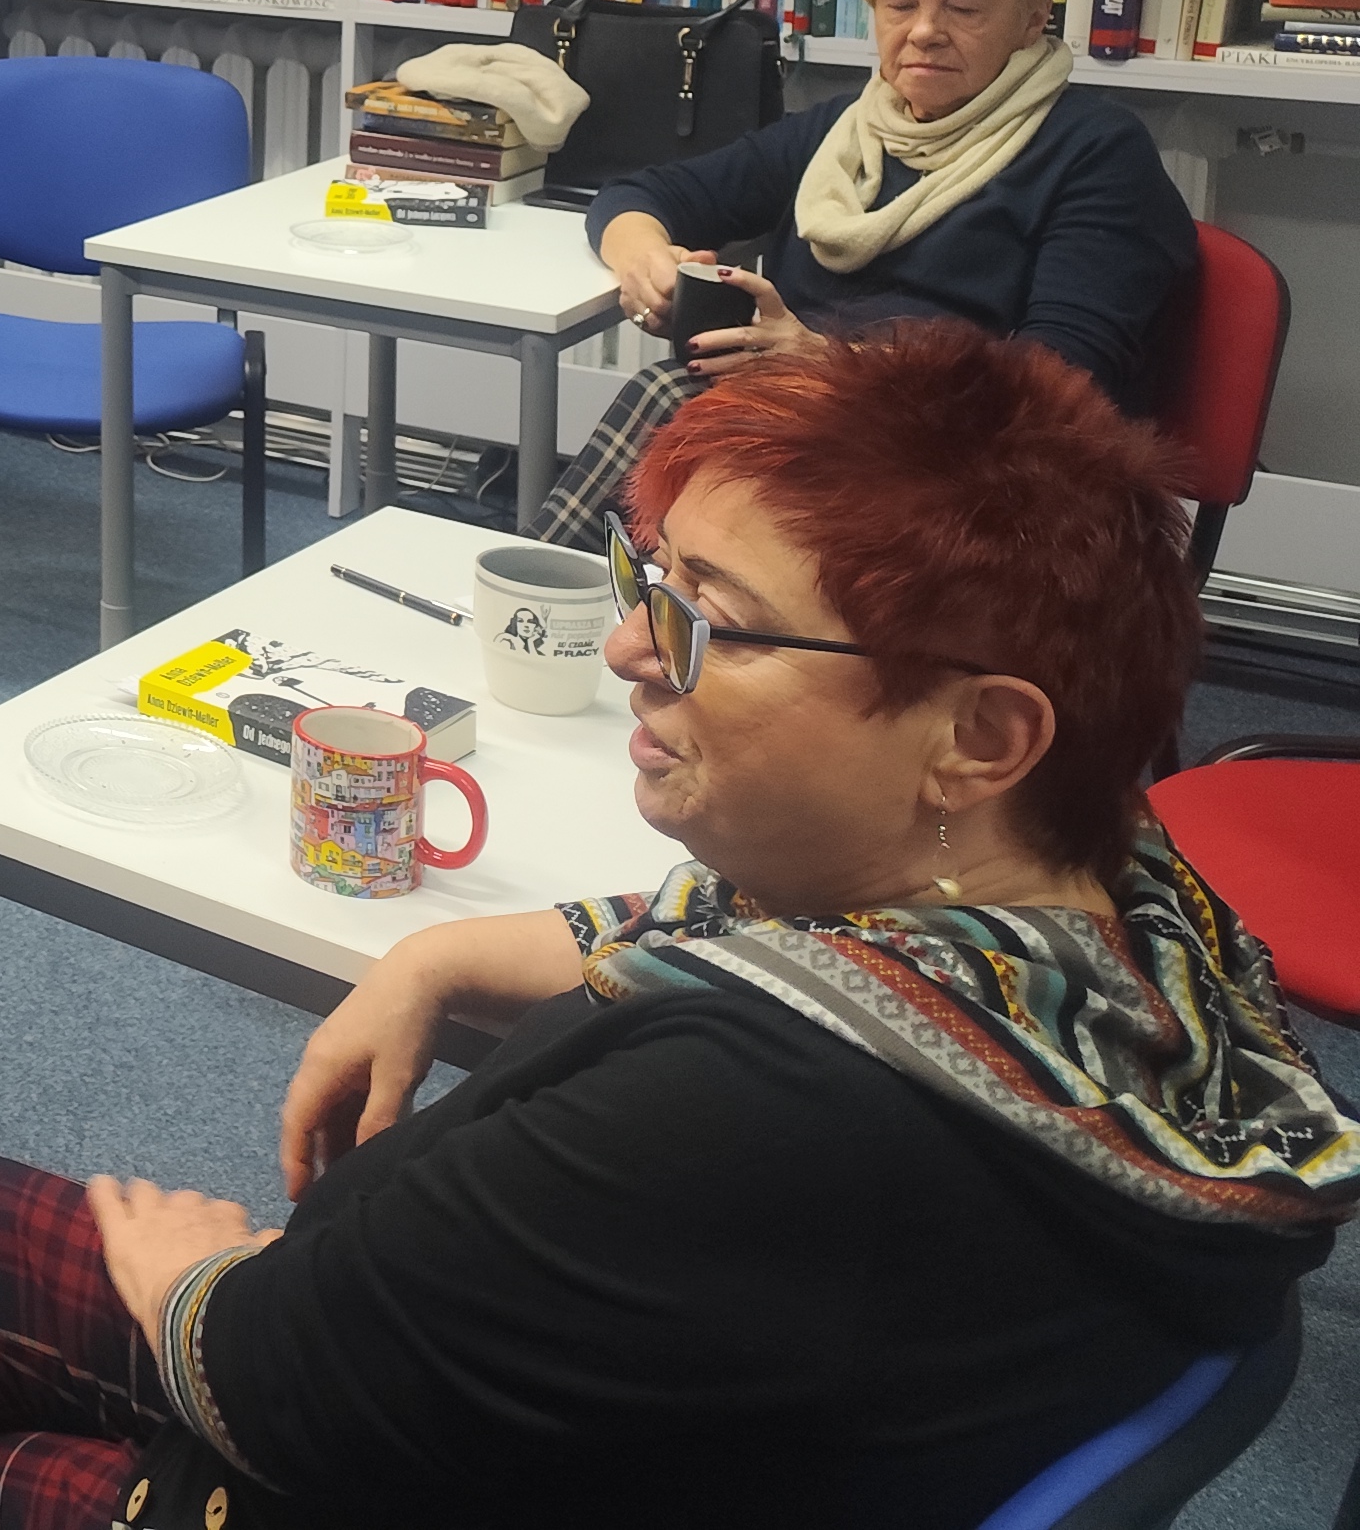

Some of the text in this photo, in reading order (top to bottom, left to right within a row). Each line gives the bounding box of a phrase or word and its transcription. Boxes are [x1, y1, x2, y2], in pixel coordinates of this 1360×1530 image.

[1220, 50, 1279, 66] PTAKI
[552, 646, 601, 659] PRACY
[568, 639, 596, 650] czasie
[162, 666, 187, 682] Anna
[146, 693, 221, 729] Anna Dziewit-Meller
[241, 723, 292, 756] Od jednego
